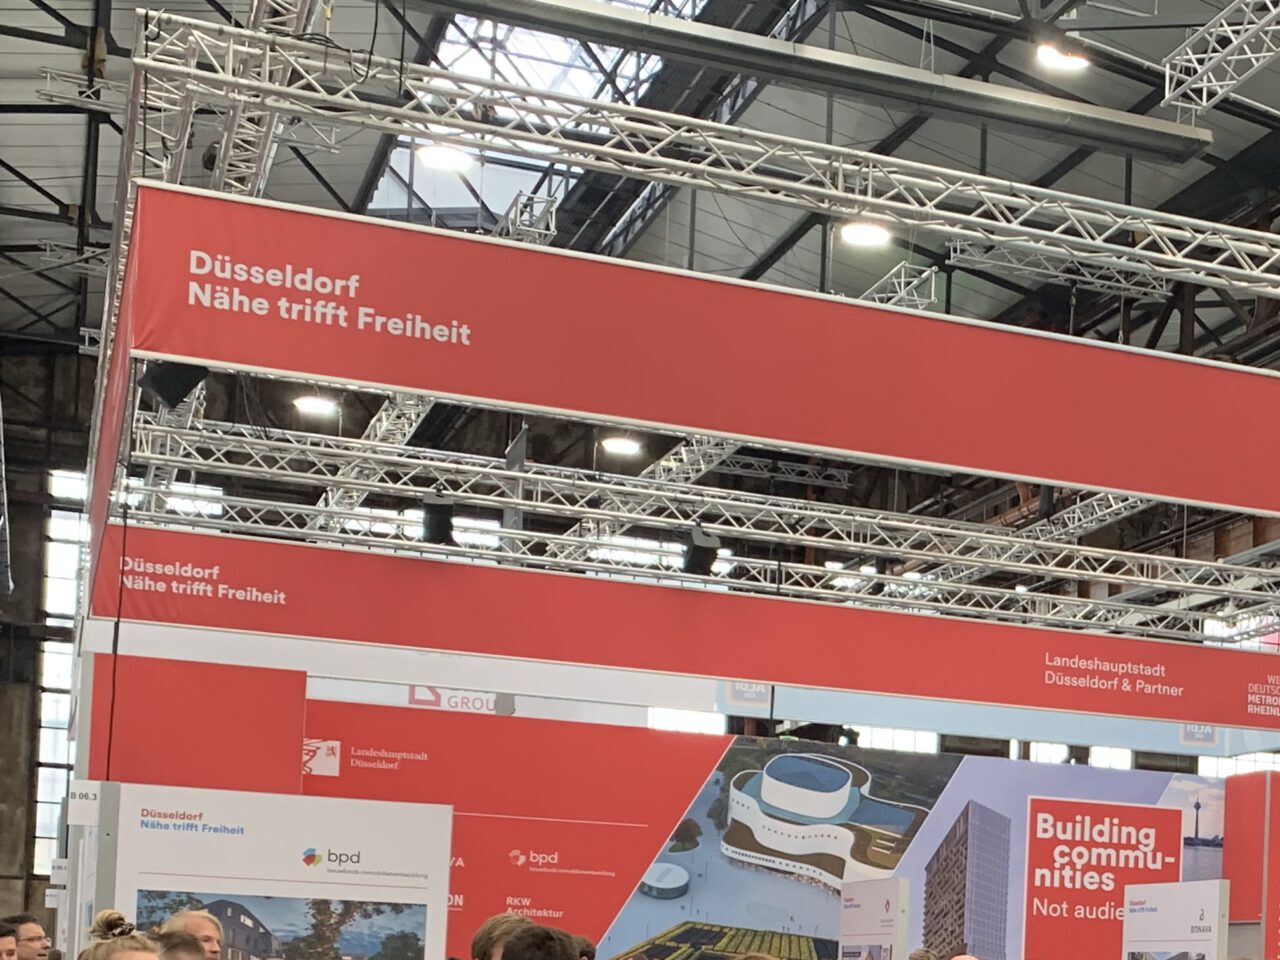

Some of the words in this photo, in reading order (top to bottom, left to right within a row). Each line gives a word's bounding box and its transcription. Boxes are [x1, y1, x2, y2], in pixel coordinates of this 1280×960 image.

[189, 250, 360, 298] Düsseldorf
[188, 282, 270, 316] Nähe
[278, 296, 349, 328] trifft
[357, 307, 471, 346] Freiheit
[119, 556, 220, 580] Düsseldorf
[119, 575, 167, 593] Nähe
[171, 579, 213, 598] trifft
[217, 584, 286, 605] Freiheit
[1045, 652, 1166, 677] Landeshauptstadt
[1045, 670, 1119, 691] Düsseldorf
[1121, 680, 1132, 692] &
[1135, 680, 1185, 697] Partner
[350, 758, 399, 770] Düsseldorf
[351, 746, 429, 761] Landeshauptstadt
[140, 808, 204, 821] Düsseldorf
[140, 819, 170, 831] Nähe
[172, 820, 199, 833] trifft
[201, 823, 245, 835] Freiheit
[1036, 813, 1156, 852] Building
[327, 849, 361, 867] bpd
[529, 850, 559, 866] bpd
[1053, 844, 1175, 870] commu-
[1034, 862, 1115, 891] nities
[506, 896, 531, 906] RKW
[506, 906, 564, 918] Architektur
[1032, 897, 1068, 917] Not
[1074, 902, 1124, 921] audie
